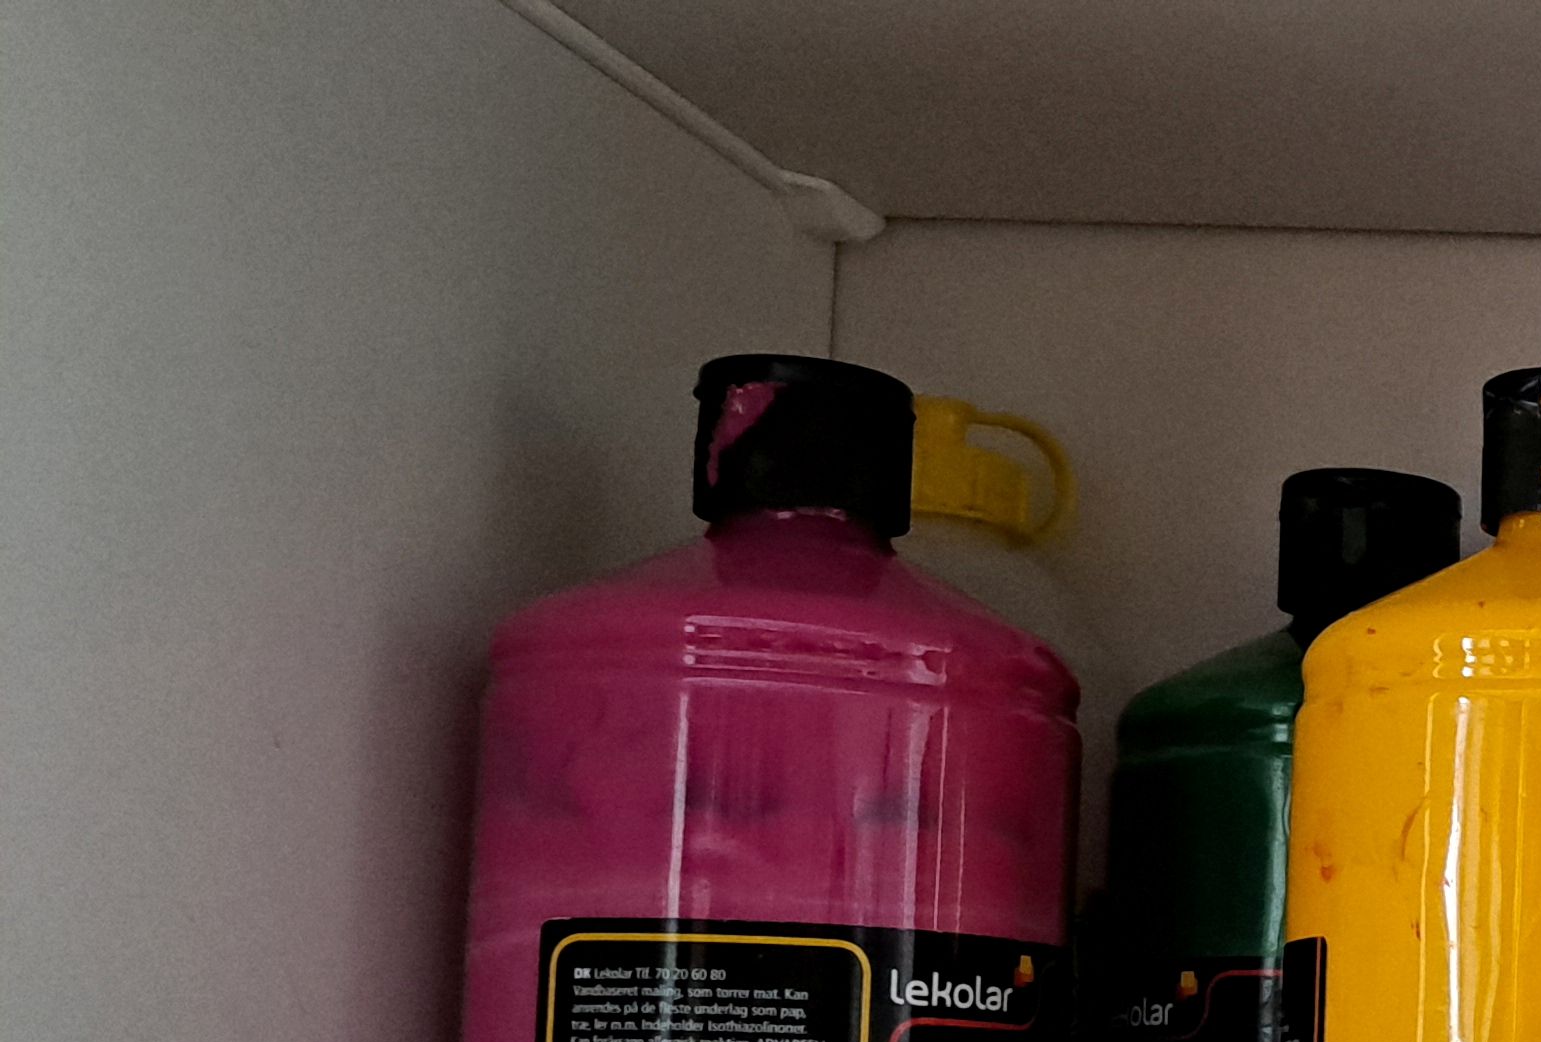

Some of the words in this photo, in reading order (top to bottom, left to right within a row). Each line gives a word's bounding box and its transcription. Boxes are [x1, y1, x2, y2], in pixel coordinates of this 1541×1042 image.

[574, 968, 591, 979] DK
[656, 968, 669, 979] 70
[675, 969, 688, 980] 20
[692, 969, 706, 980] 60
[711, 970, 726, 980] 80
[785, 989, 808, 1000] Kan
